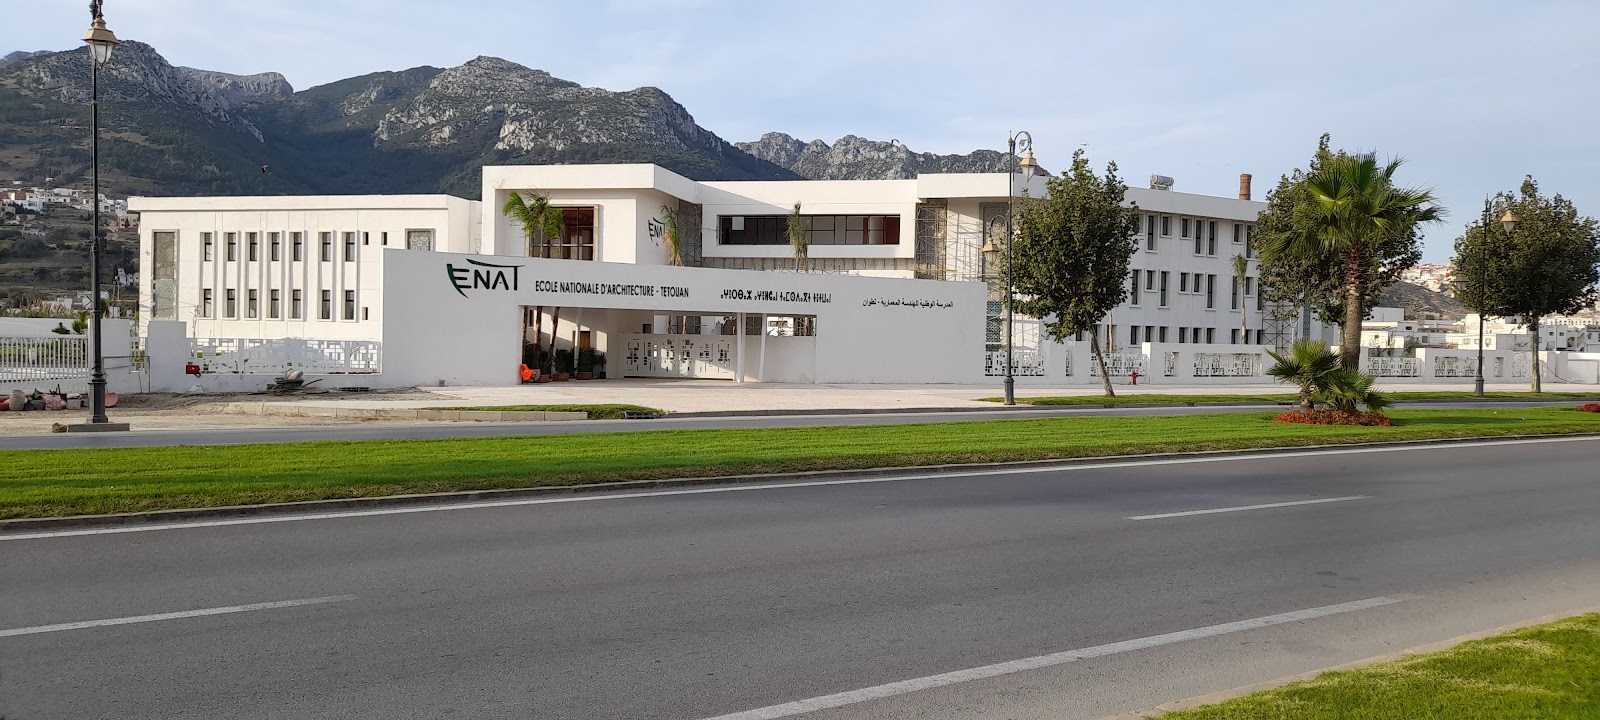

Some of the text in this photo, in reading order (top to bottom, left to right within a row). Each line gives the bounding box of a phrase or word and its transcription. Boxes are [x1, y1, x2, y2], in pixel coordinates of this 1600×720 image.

[446, 258, 525, 299] ENAT
[535, 280, 558, 293] ECOLE
[559, 281, 600, 295] NATIONALE
[600, 283, 655, 297] D'ARCHITECTURE
[660, 285, 689, 298] TETOUAN
[862, 297, 877, 307] تطوان
[881, 297, 901, 308] المعمارية
[901, 297, 919, 308] للهندسة
[919, 298, 936, 309] الوطنية
[936, 299, 954, 309] المدرسة
